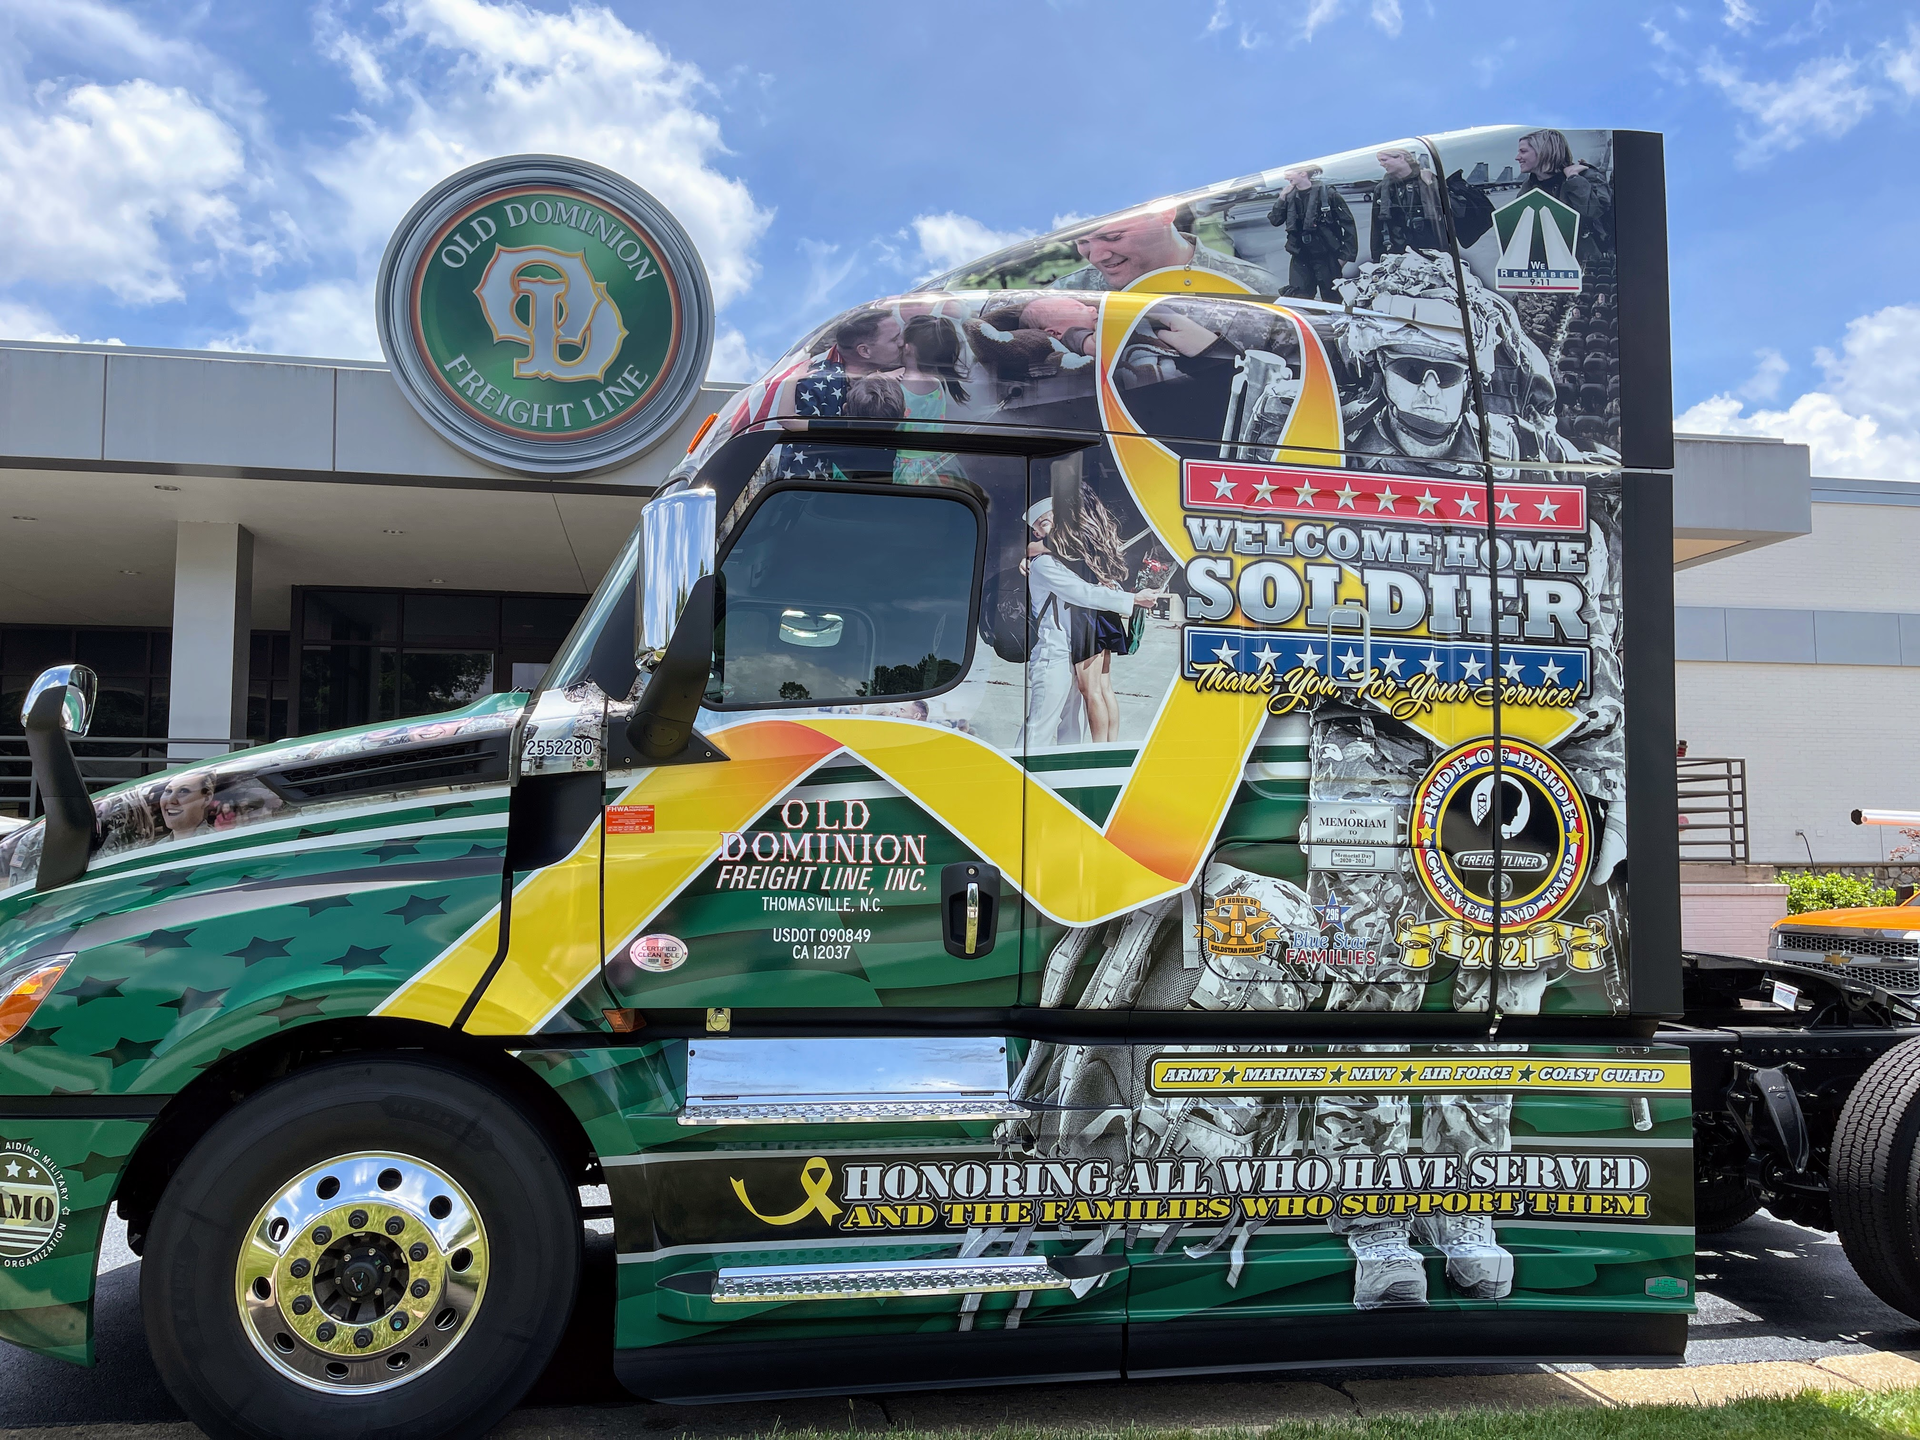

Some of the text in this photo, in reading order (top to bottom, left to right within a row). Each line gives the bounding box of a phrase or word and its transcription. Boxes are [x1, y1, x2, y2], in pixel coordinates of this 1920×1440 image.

[441, 201, 657, 283] OLD DOMINION
[1500, 269, 1574, 278] REMEMBER
[443, 353, 649, 428] FREIGHT LINE
[1186, 516, 1588, 573] WELCOME HOME
[1185, 556, 1590, 641] SOLDIER
[1191, 660, 1584, 720] Thank You, For Your Service!
[526, 740, 593, 757] 2552280
[1422, 748, 1579, 821] RIDE OF PRIDE
[780, 799, 871, 830] OLD
[1319, 817, 1387, 828] MEMORIAM
[718, 831, 927, 865] DOMINION
[1462, 855, 1539, 867] FREIGTLINER
[716, 865, 927, 895] FREIGHT LINE, INC.
[1425, 850, 1577, 925] CLEVELAND TMP
[761, 897, 884, 913] THOMASVILLE, N.C.
[1326, 908, 1339, 921] 296
[773, 928, 871, 943] USDOT 090849
[1234, 922, 1242, 935] 13
[1293, 932, 1371, 949] Blue Star
[792, 946, 850, 960] CA 12037
[1286, 949, 1376, 965] FAMILIES
[1463, 935, 1538, 967] 2021
[1161, 1066, 1664, 1083] ARMY MARINES NAVY AIR FORCE COAST GUARD
[5, 1142, 69, 1201] AIDING MILITARY
[844, 1155, 1651, 1201] HONORING ALL WHO HAVE SERVED
[843, 1192, 1650, 1230] AND THE FAMILIES WHO SUPPORT THEM
[4, 1222, 67, 1268] ORGANIZATION
